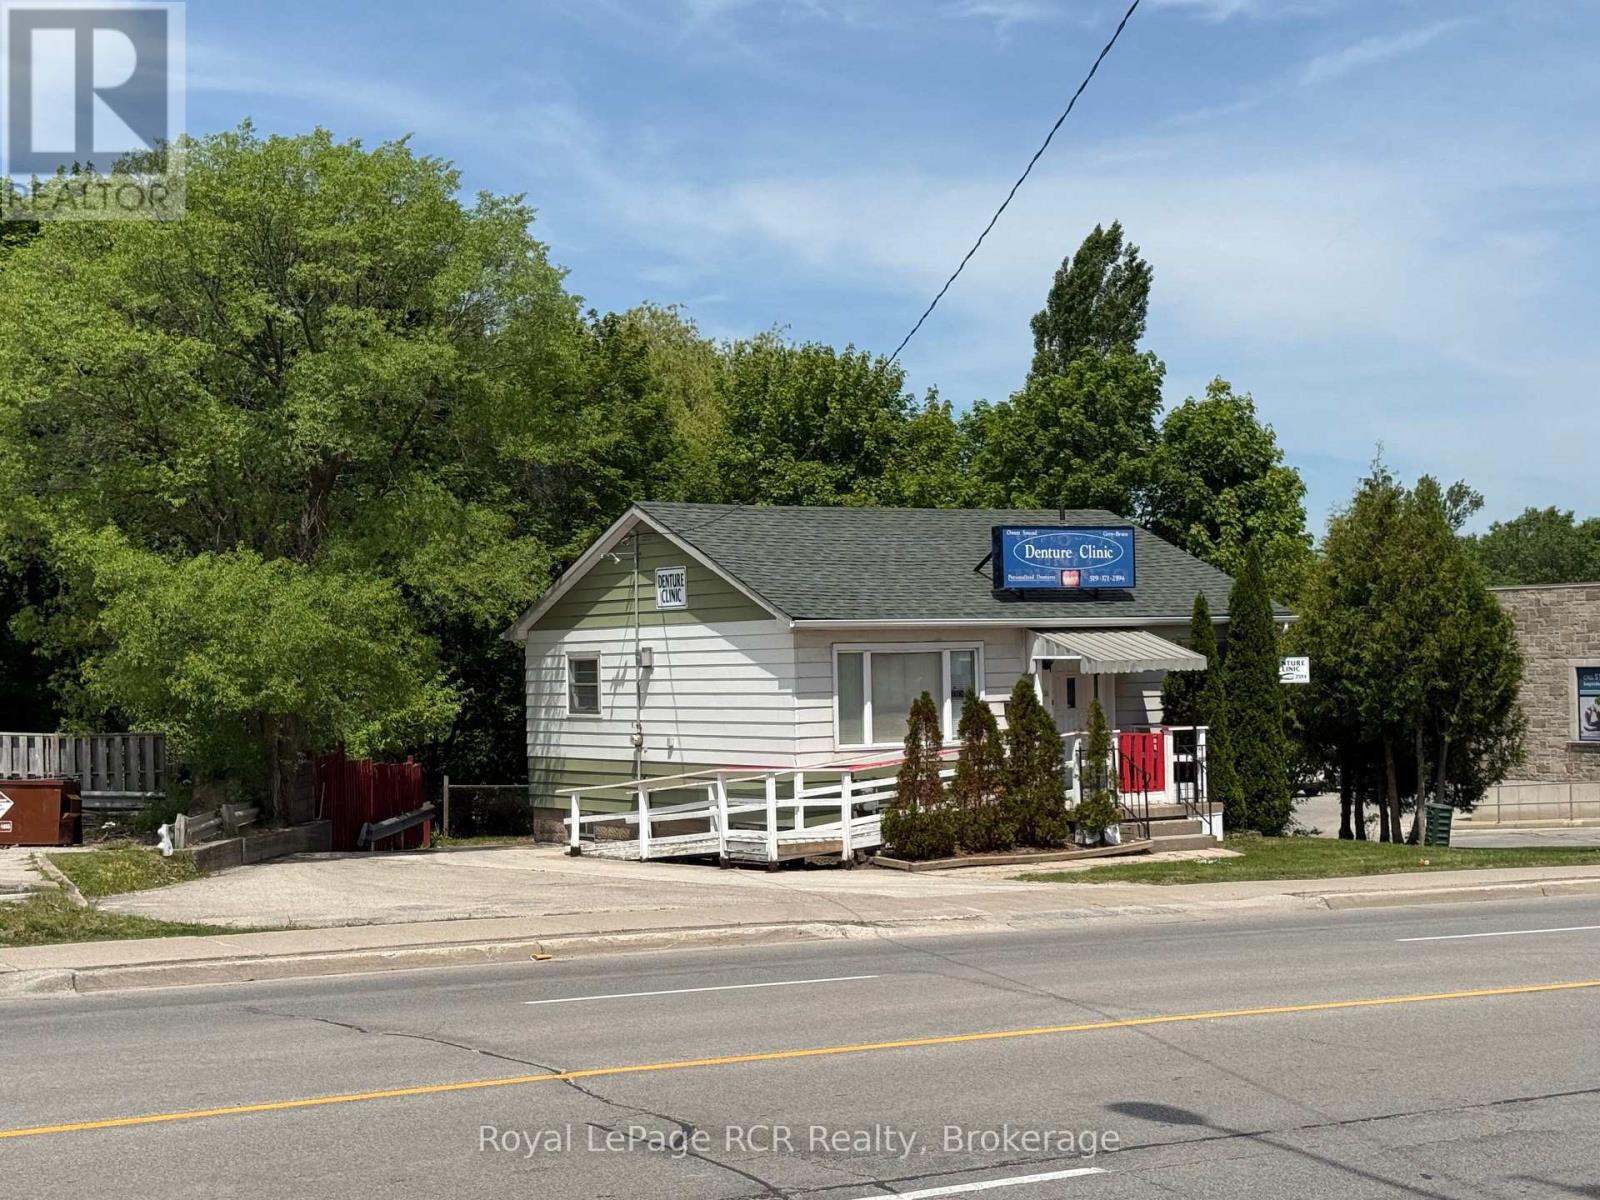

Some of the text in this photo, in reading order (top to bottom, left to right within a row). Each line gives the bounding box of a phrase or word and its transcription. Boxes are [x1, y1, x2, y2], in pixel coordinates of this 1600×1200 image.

[1024, 544, 1114, 559] Denture Clinic
[657, 573, 684, 589] DENTURE
[661, 588, 682, 603] CLINIC
